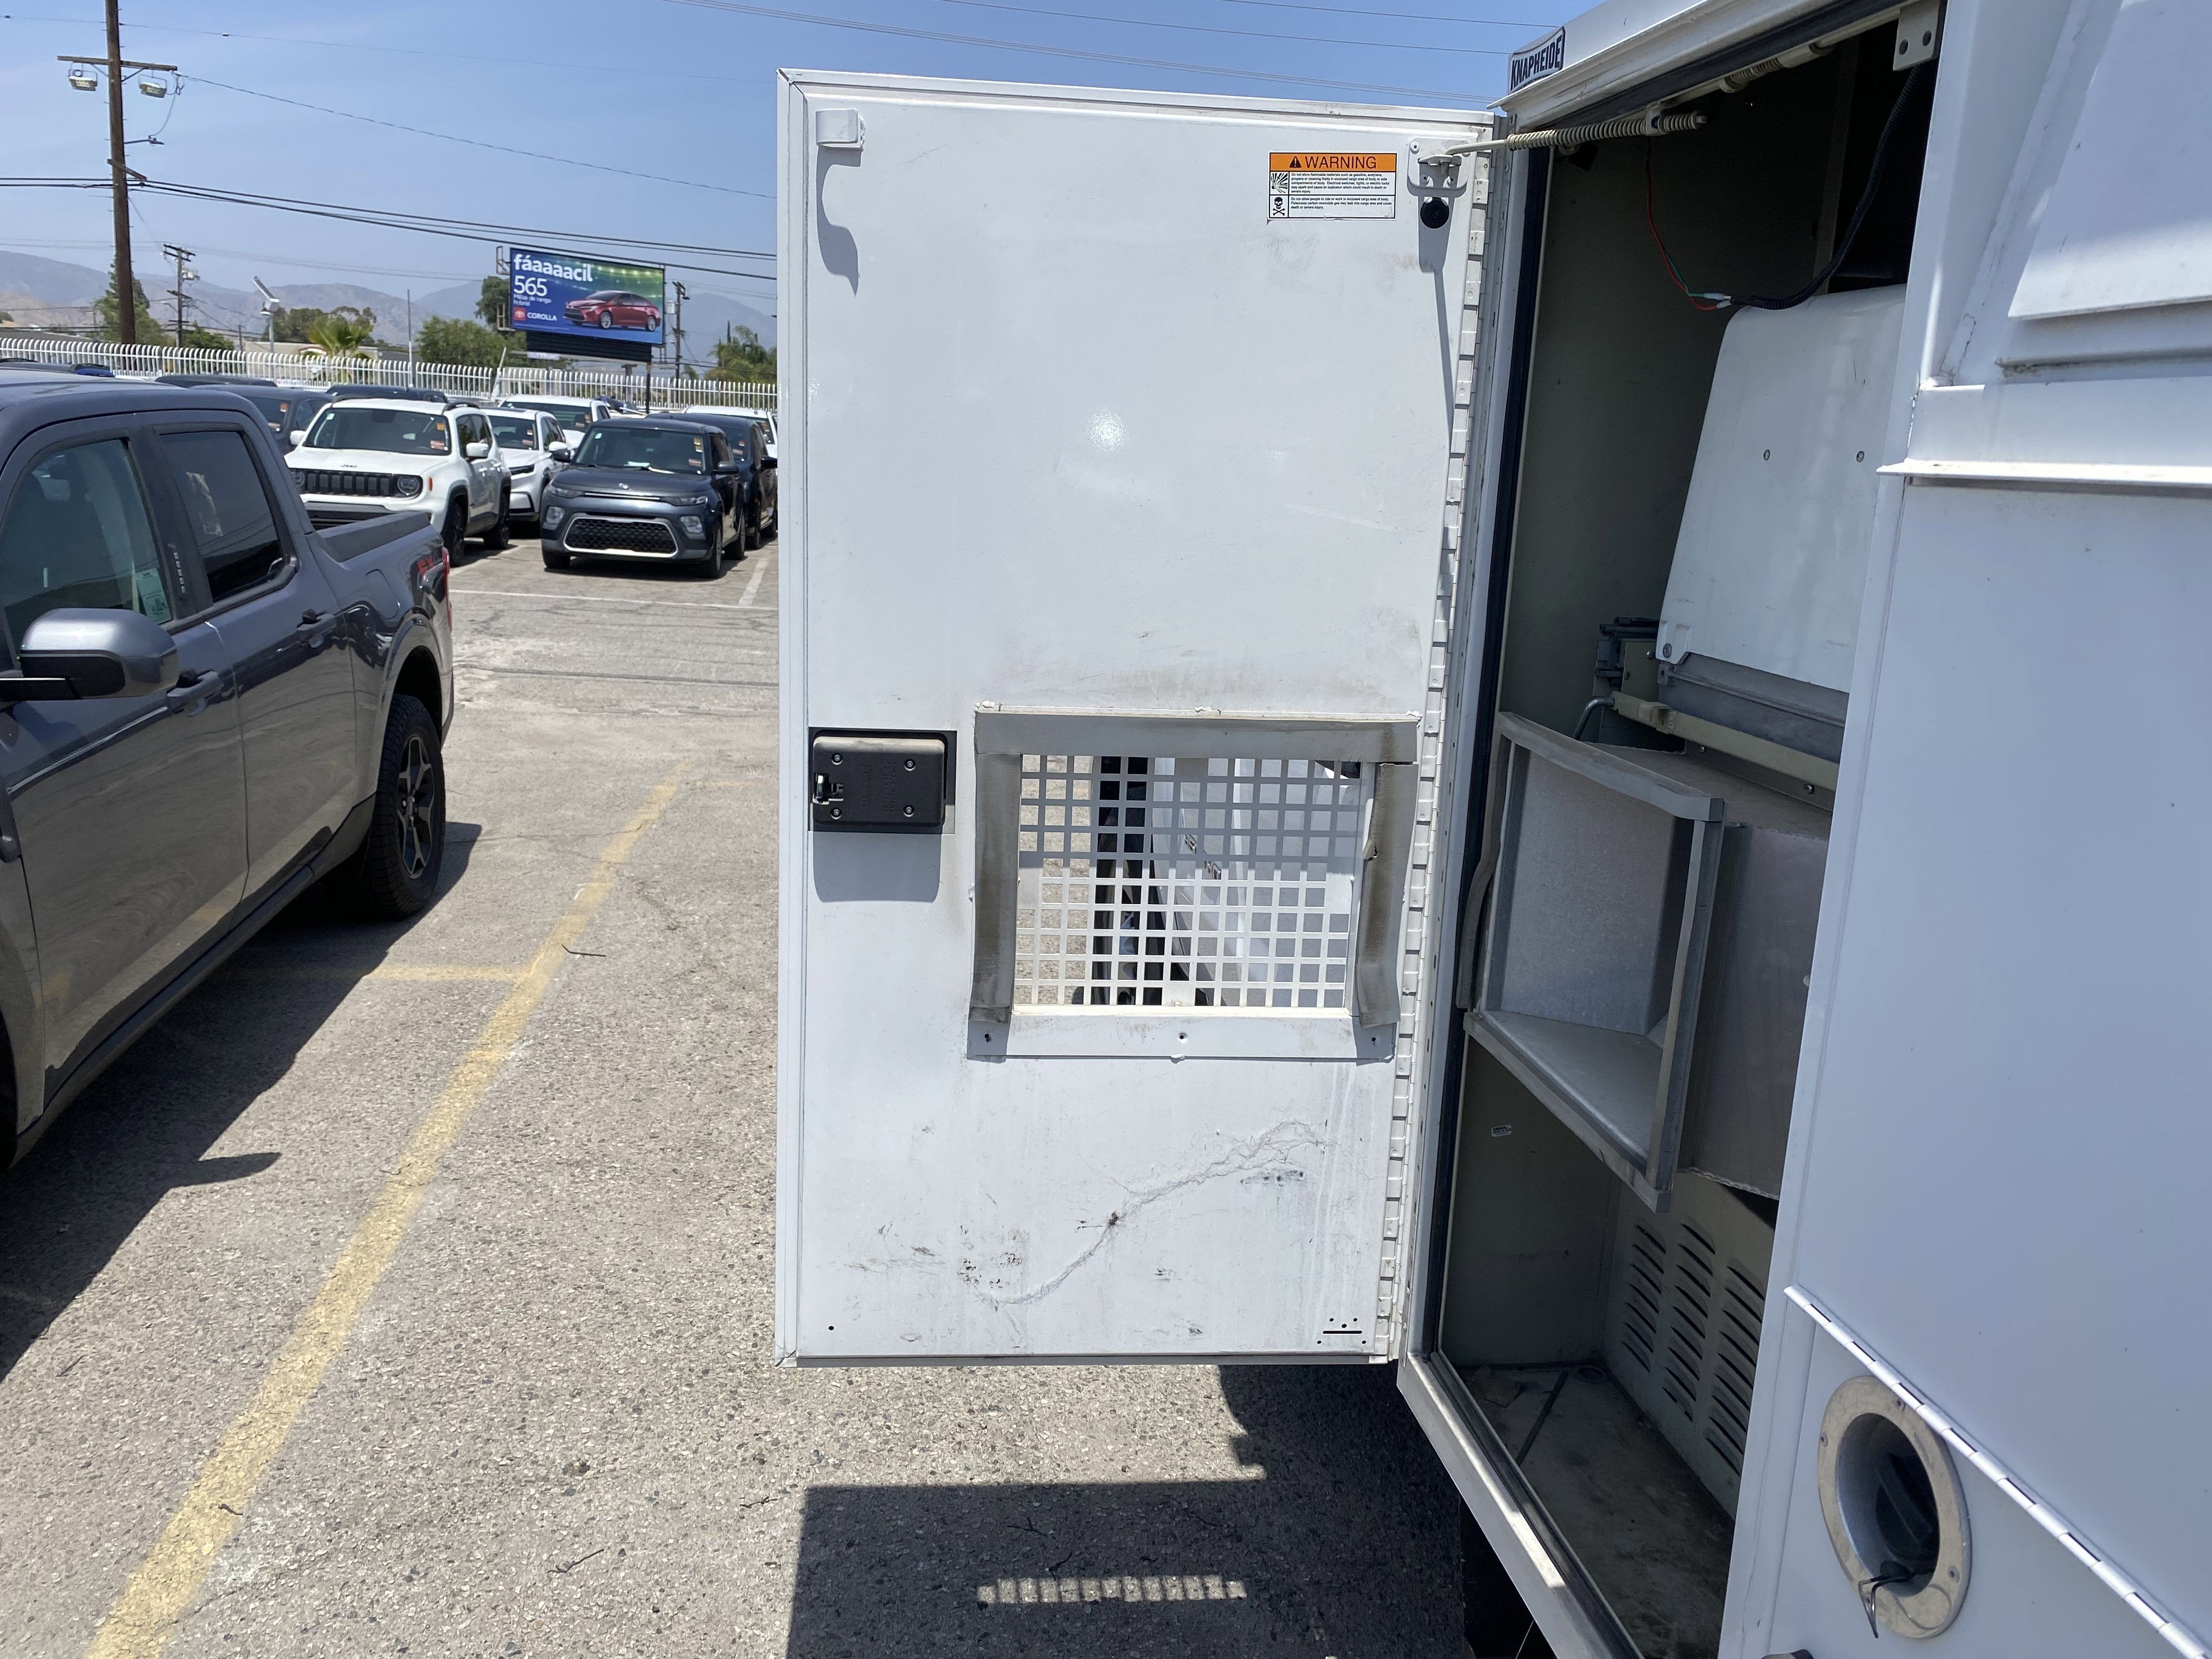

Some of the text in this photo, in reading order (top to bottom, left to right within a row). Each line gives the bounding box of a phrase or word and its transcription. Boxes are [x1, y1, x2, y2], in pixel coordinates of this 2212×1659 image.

[1510, 35, 1562, 92] KNAPHEIDE
[1305, 156, 1376, 169] WARNING
[514, 254, 593, 282] fáaaaacil
[514, 275, 548, 297] 565
[527, 312, 557, 321] COROLLA
